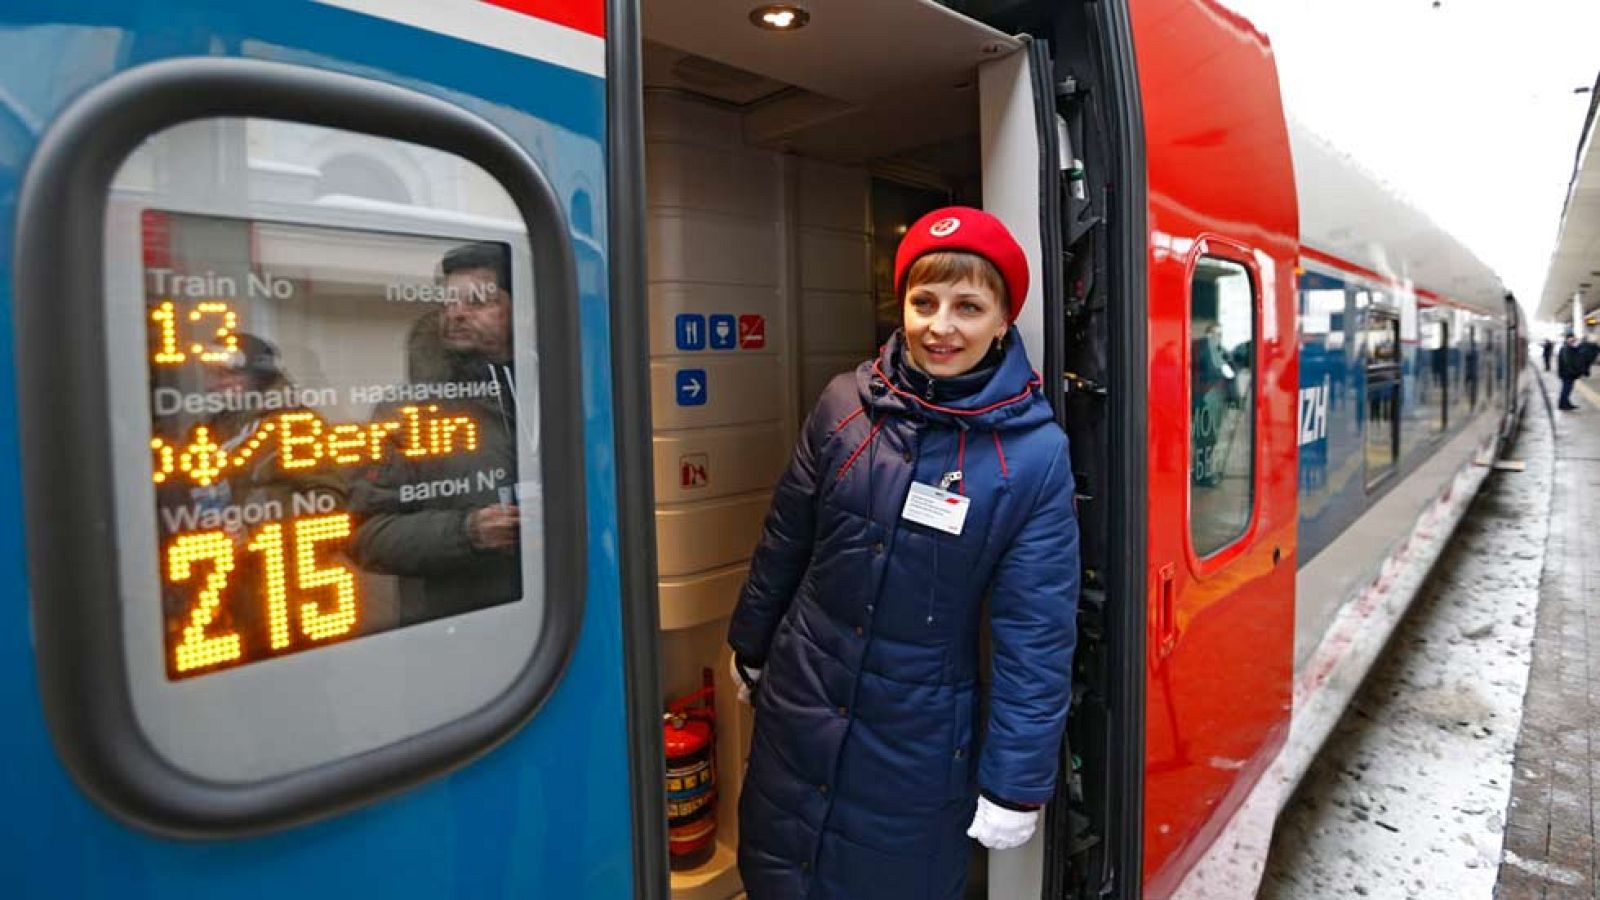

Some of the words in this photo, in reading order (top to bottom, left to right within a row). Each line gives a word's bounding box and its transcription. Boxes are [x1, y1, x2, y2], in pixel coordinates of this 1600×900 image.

[148, 268, 236, 297] Train
[248, 271, 293, 300] No
[386, 282, 462, 307] поезд
[152, 301, 239, 364] 13
[154, 383, 338, 416] Destination
[351, 379, 501, 404] назначение
[401, 477, 470, 503] вагон
[161, 499, 283, 533] Wagon
[292, 489, 337, 515] No
[168, 513, 357, 672] 215
